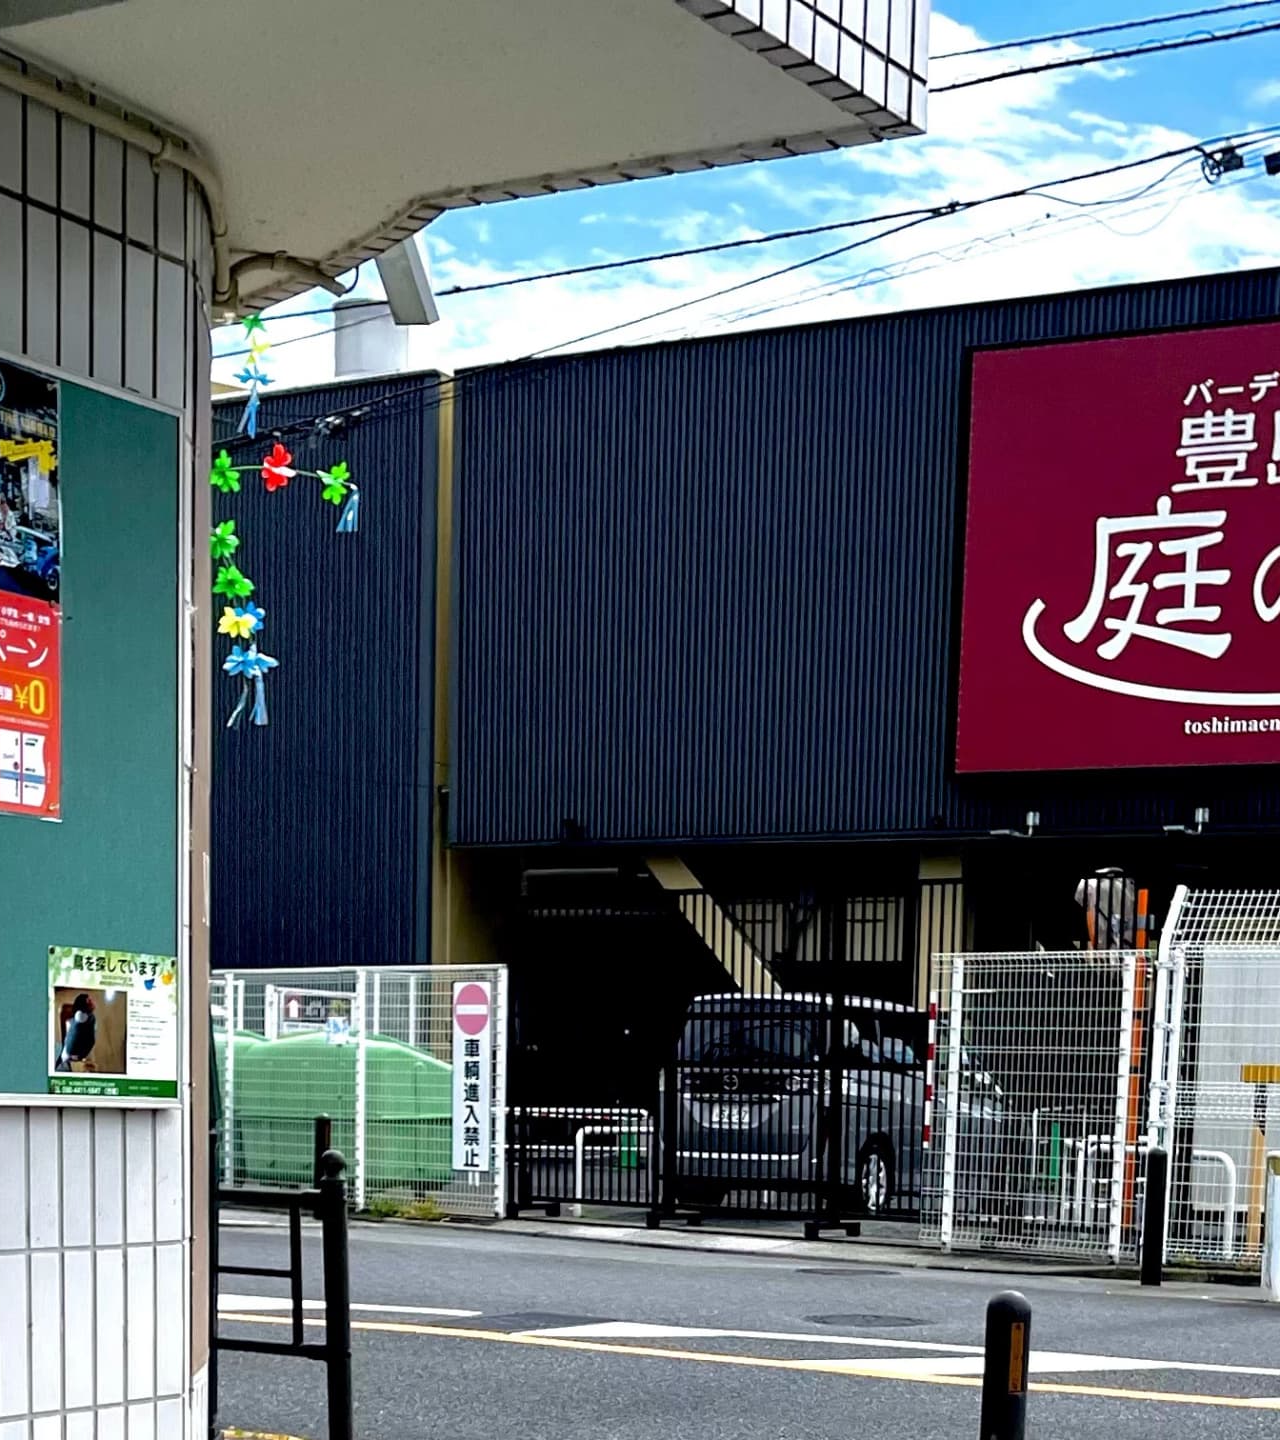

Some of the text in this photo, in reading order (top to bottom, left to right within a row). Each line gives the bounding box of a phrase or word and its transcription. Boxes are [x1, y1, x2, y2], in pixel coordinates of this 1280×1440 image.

[73, 954, 160, 977] 鳥を探しています
